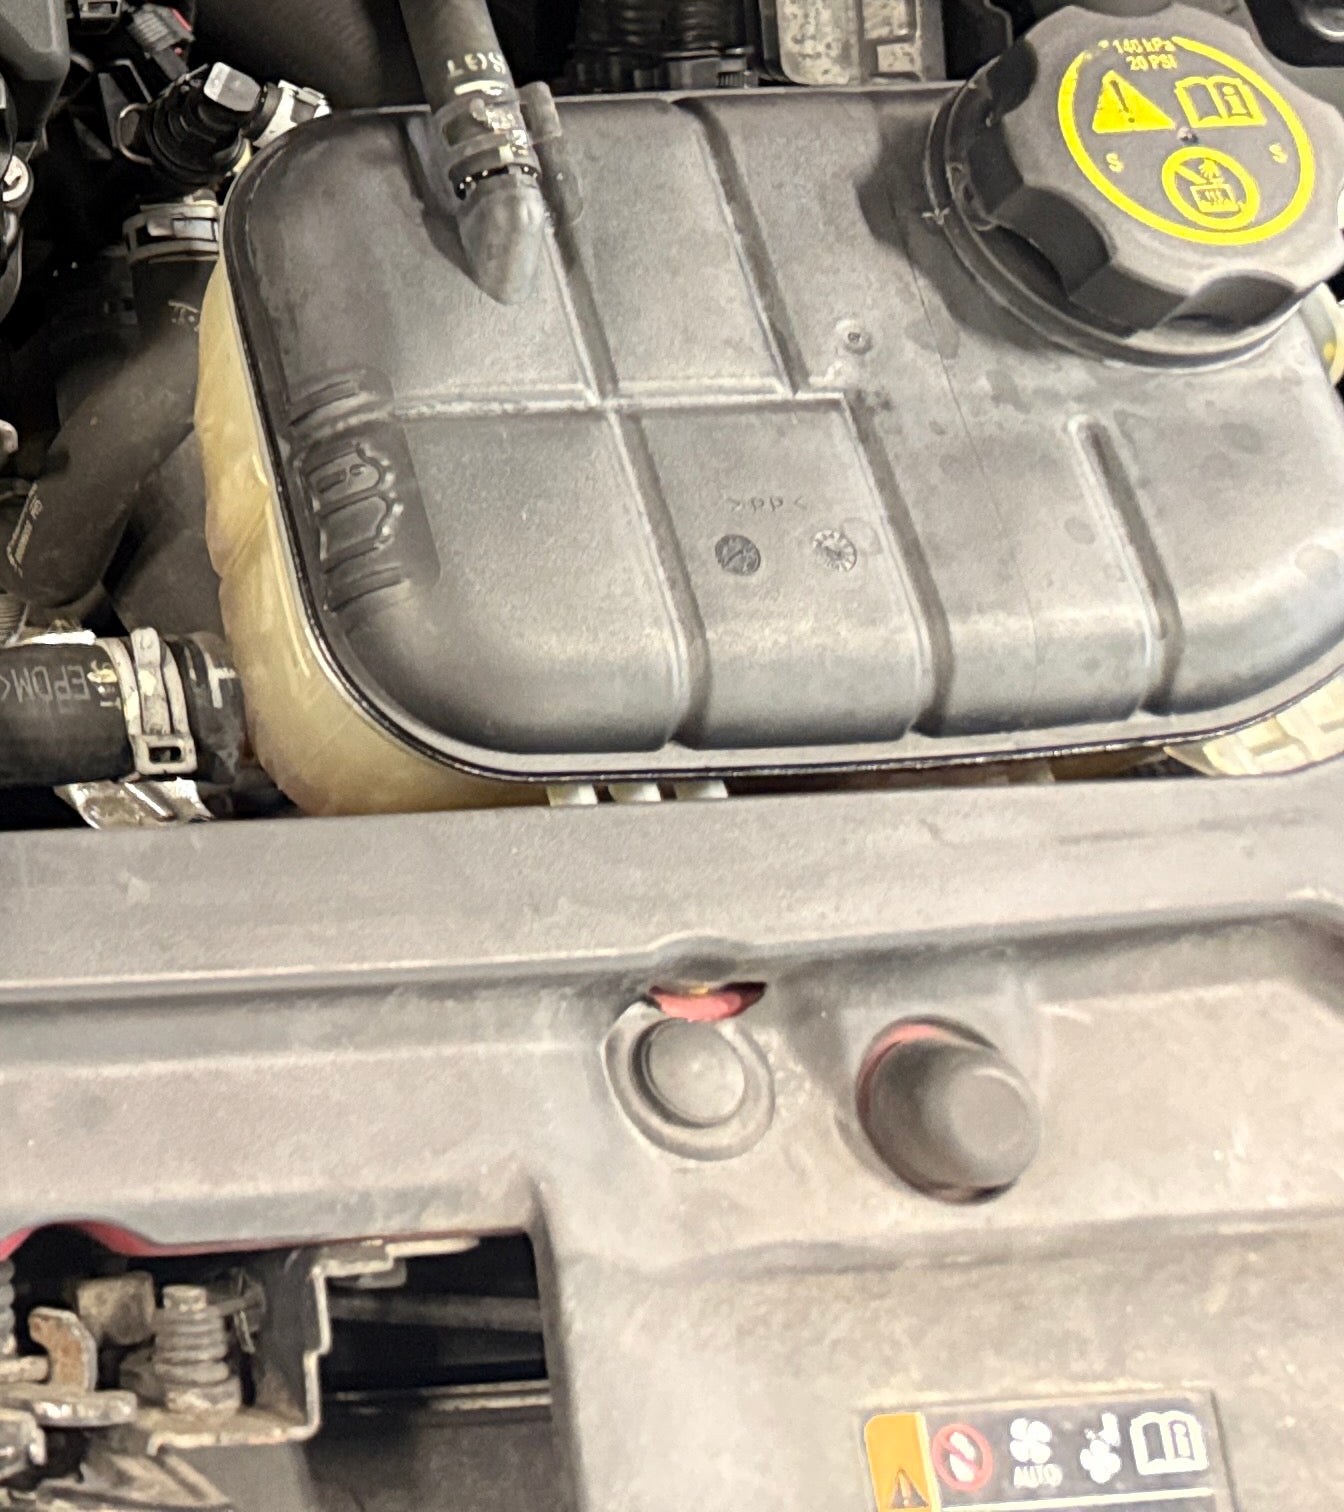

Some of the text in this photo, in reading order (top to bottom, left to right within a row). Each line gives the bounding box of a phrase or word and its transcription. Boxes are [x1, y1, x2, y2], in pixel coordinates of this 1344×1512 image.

[1125, 53, 1178, 71] 20 PSI
[1014, 1462, 1063, 1488] AUTO
